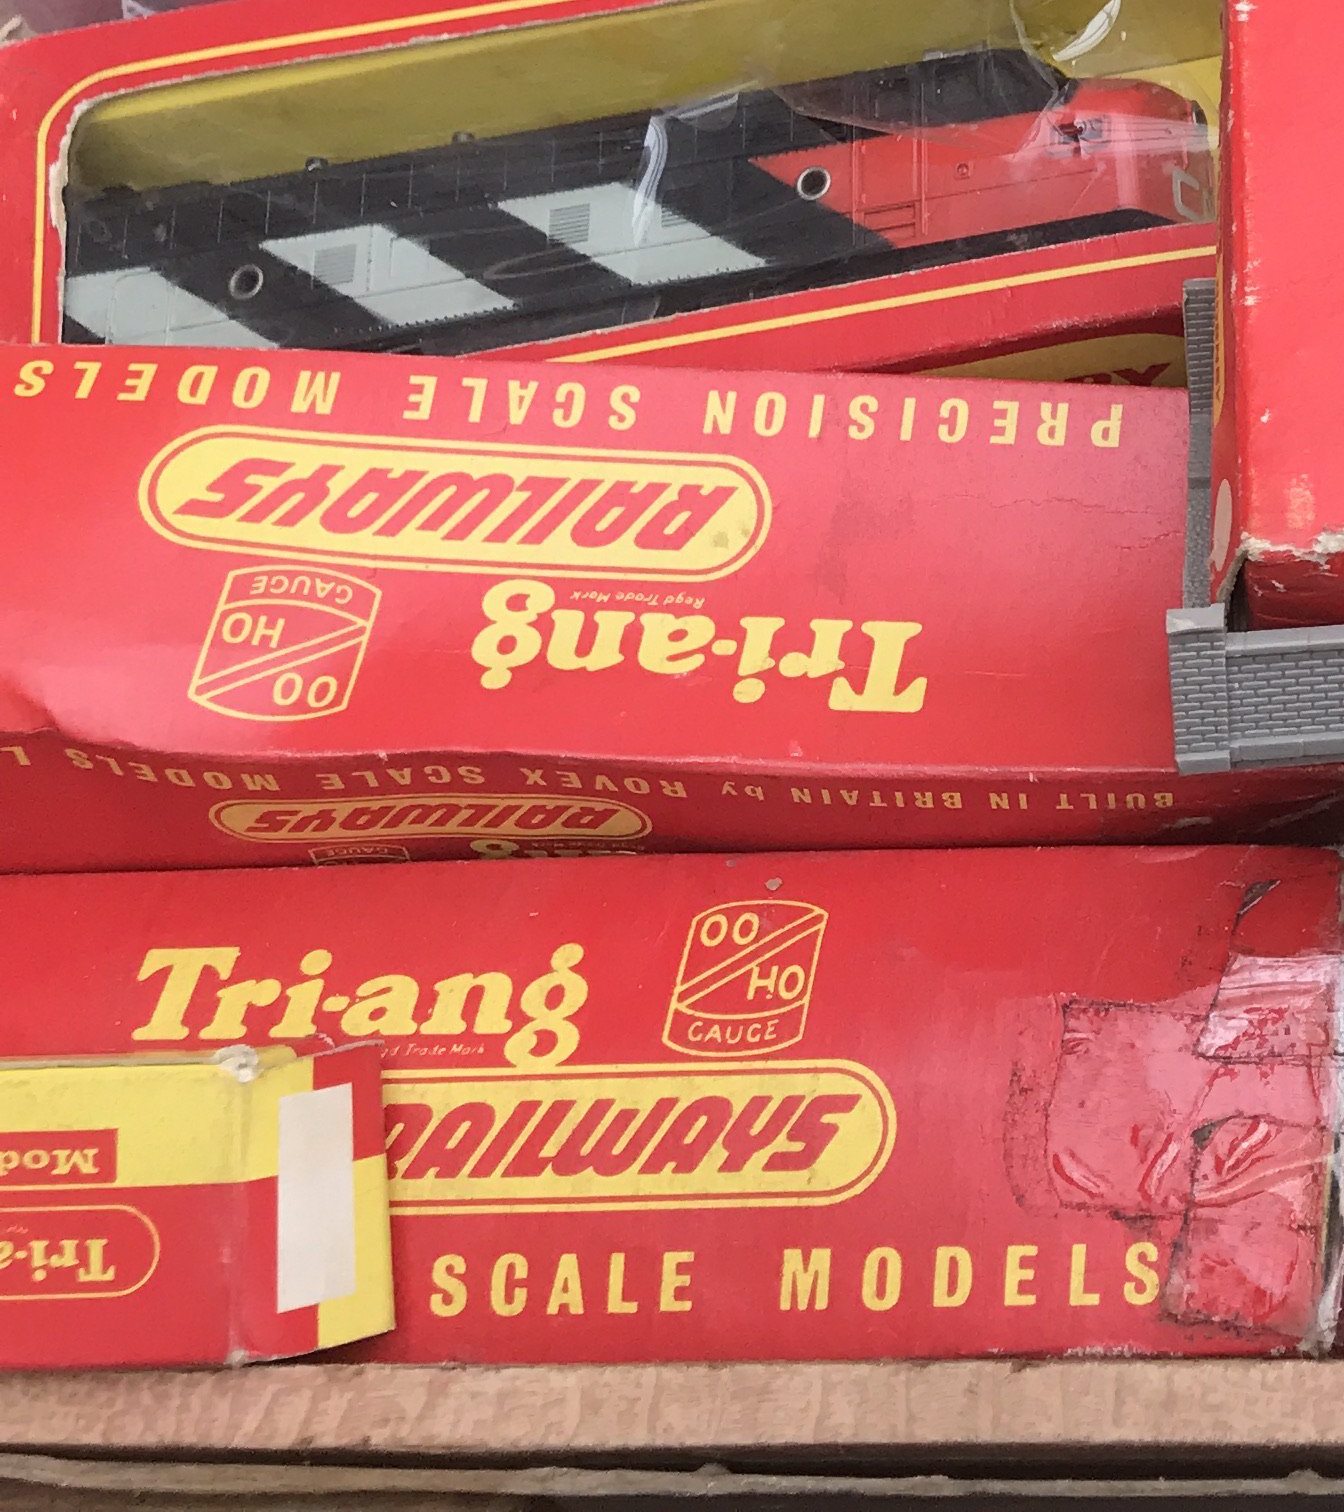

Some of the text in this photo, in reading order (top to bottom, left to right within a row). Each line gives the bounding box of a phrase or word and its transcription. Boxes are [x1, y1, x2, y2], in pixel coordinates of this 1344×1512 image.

[14, 360, 1123, 447] PRECISION SCALE MODELS
[172, 457, 739, 552] RAILWAYS
[250, 575, 354, 605] GAUGE
[571, 590, 610, 604] Mark
[616, 592, 665, 605] Trade
[223, 612, 286, 648] HO
[471, 579, 928, 712] Tri-ang
[272, 675, 338, 709] OO
[64, 747, 1174, 810] BUILT IN BRITAIN by ROVEX SCALE MODELS
[246, 804, 620, 833] RAILWAYS
[700, 914, 759, 948] OO
[130, 942, 588, 1068] Tri-ang
[687, 1017, 777, 1043] GAUGE
[403, 1043, 446, 1056] Trade
[448, 1042, 485, 1056] Mark
[430, 1242, 1160, 1318] SCALE MODELS
